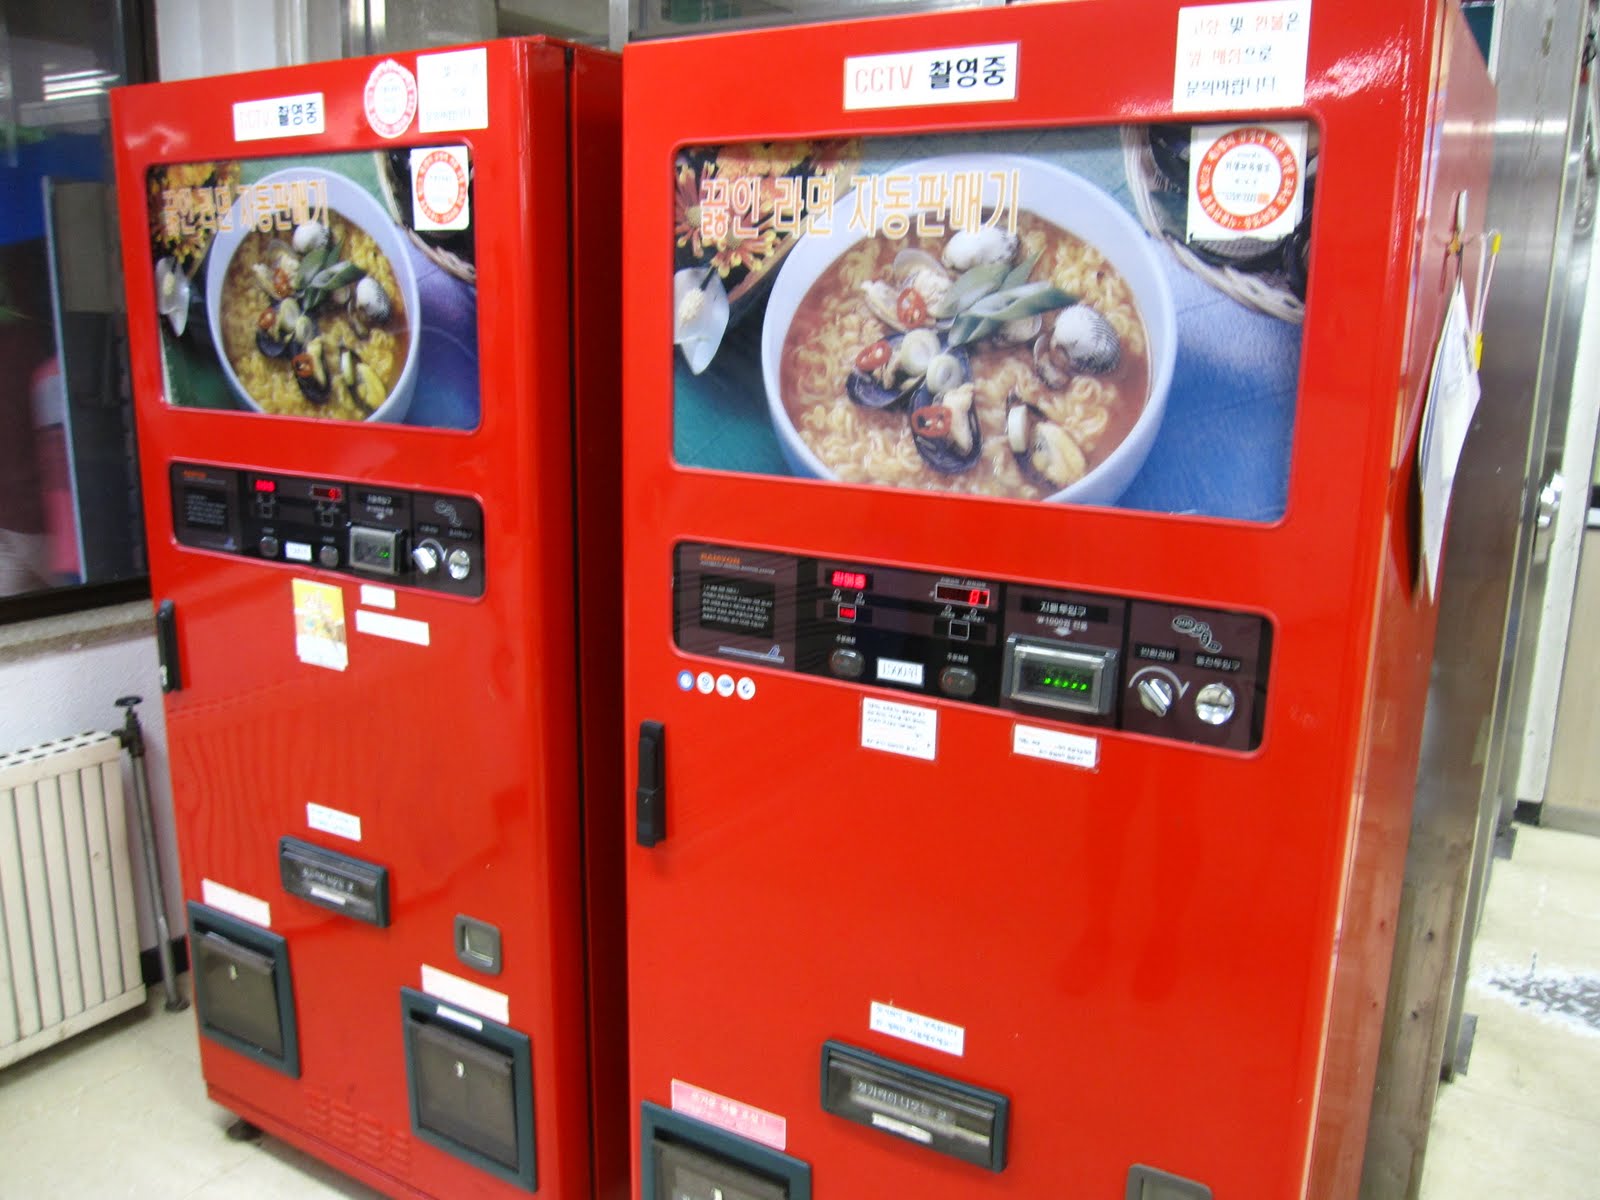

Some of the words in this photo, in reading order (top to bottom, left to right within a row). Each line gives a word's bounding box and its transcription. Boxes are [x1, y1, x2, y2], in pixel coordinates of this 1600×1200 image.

[1229, 15, 1245, 34] 및
[854, 68, 915, 95] CCTV
[928, 55, 1007, 90] 촬영중
[277, 101, 318, 127] 촬영중
[239, 178, 330, 234] 자동판매기
[700, 175, 762, 240] 끓인
[773, 173, 836, 239] 라면
[848, 168, 1021, 239] 자동판매기
